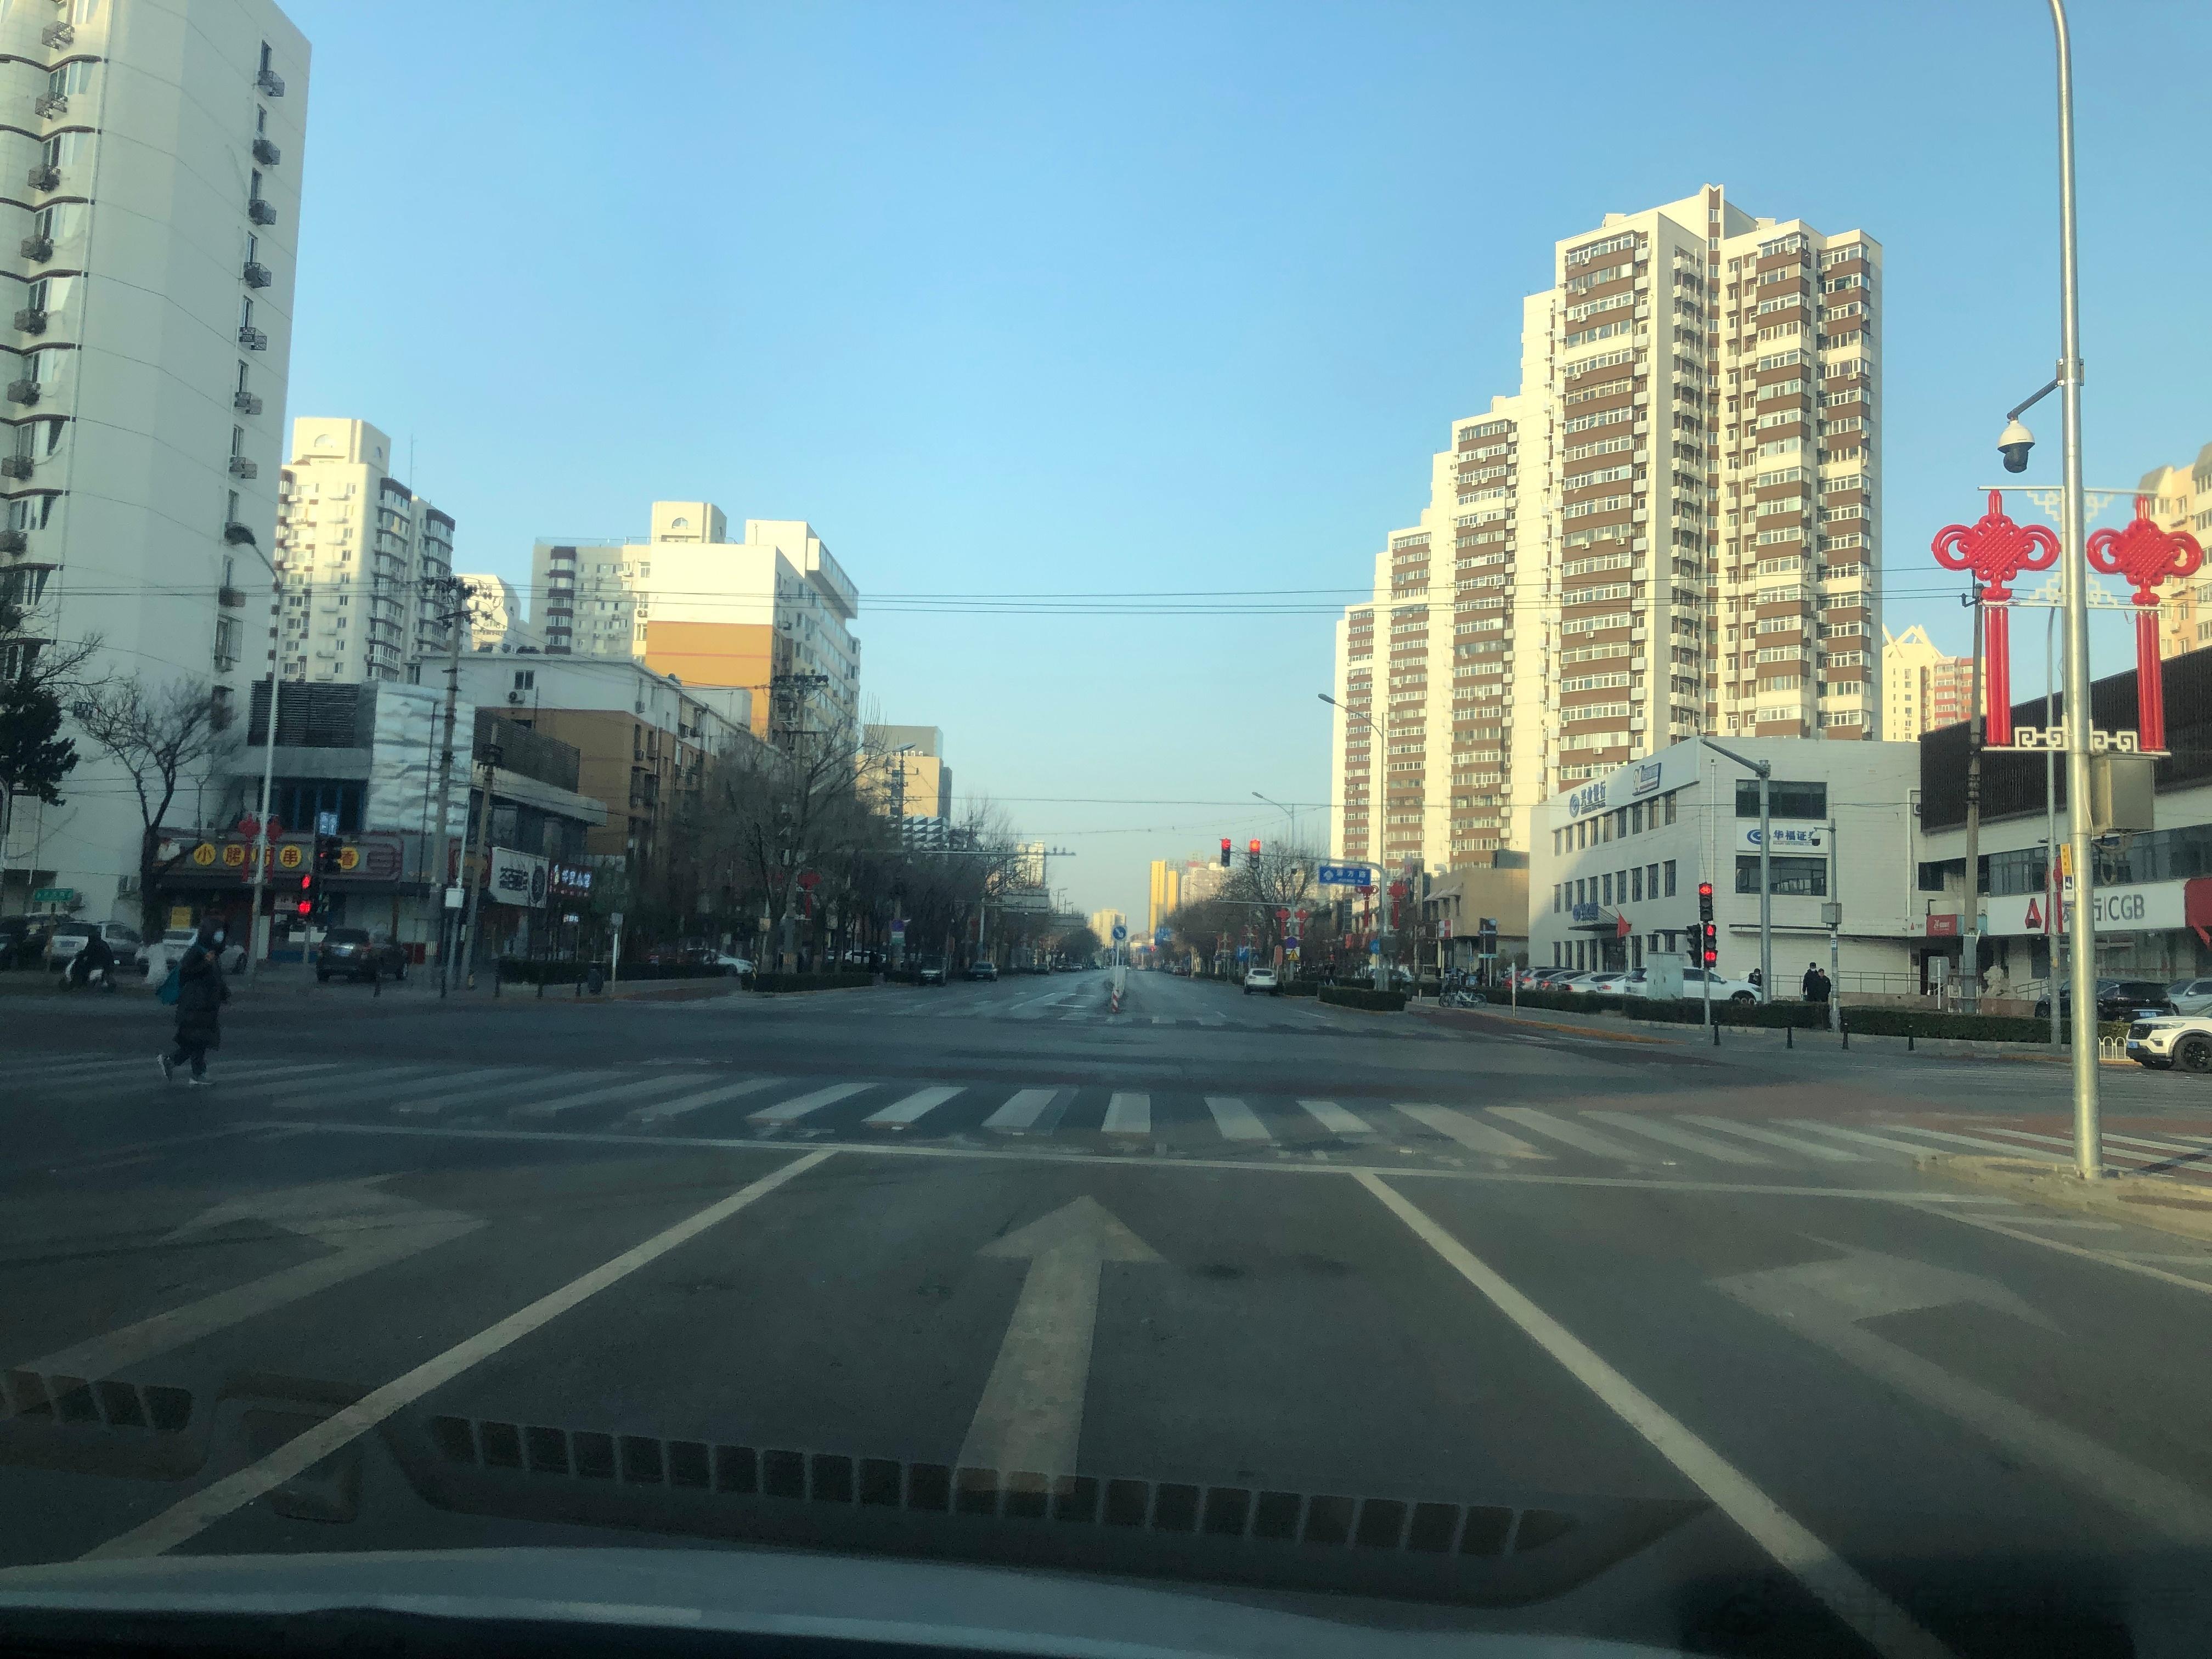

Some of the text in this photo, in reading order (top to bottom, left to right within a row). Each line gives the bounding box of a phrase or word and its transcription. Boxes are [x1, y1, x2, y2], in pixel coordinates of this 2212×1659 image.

[1581, 780, 1606, 807] 兴业银行
[2108, 894, 2145, 921] CGB
